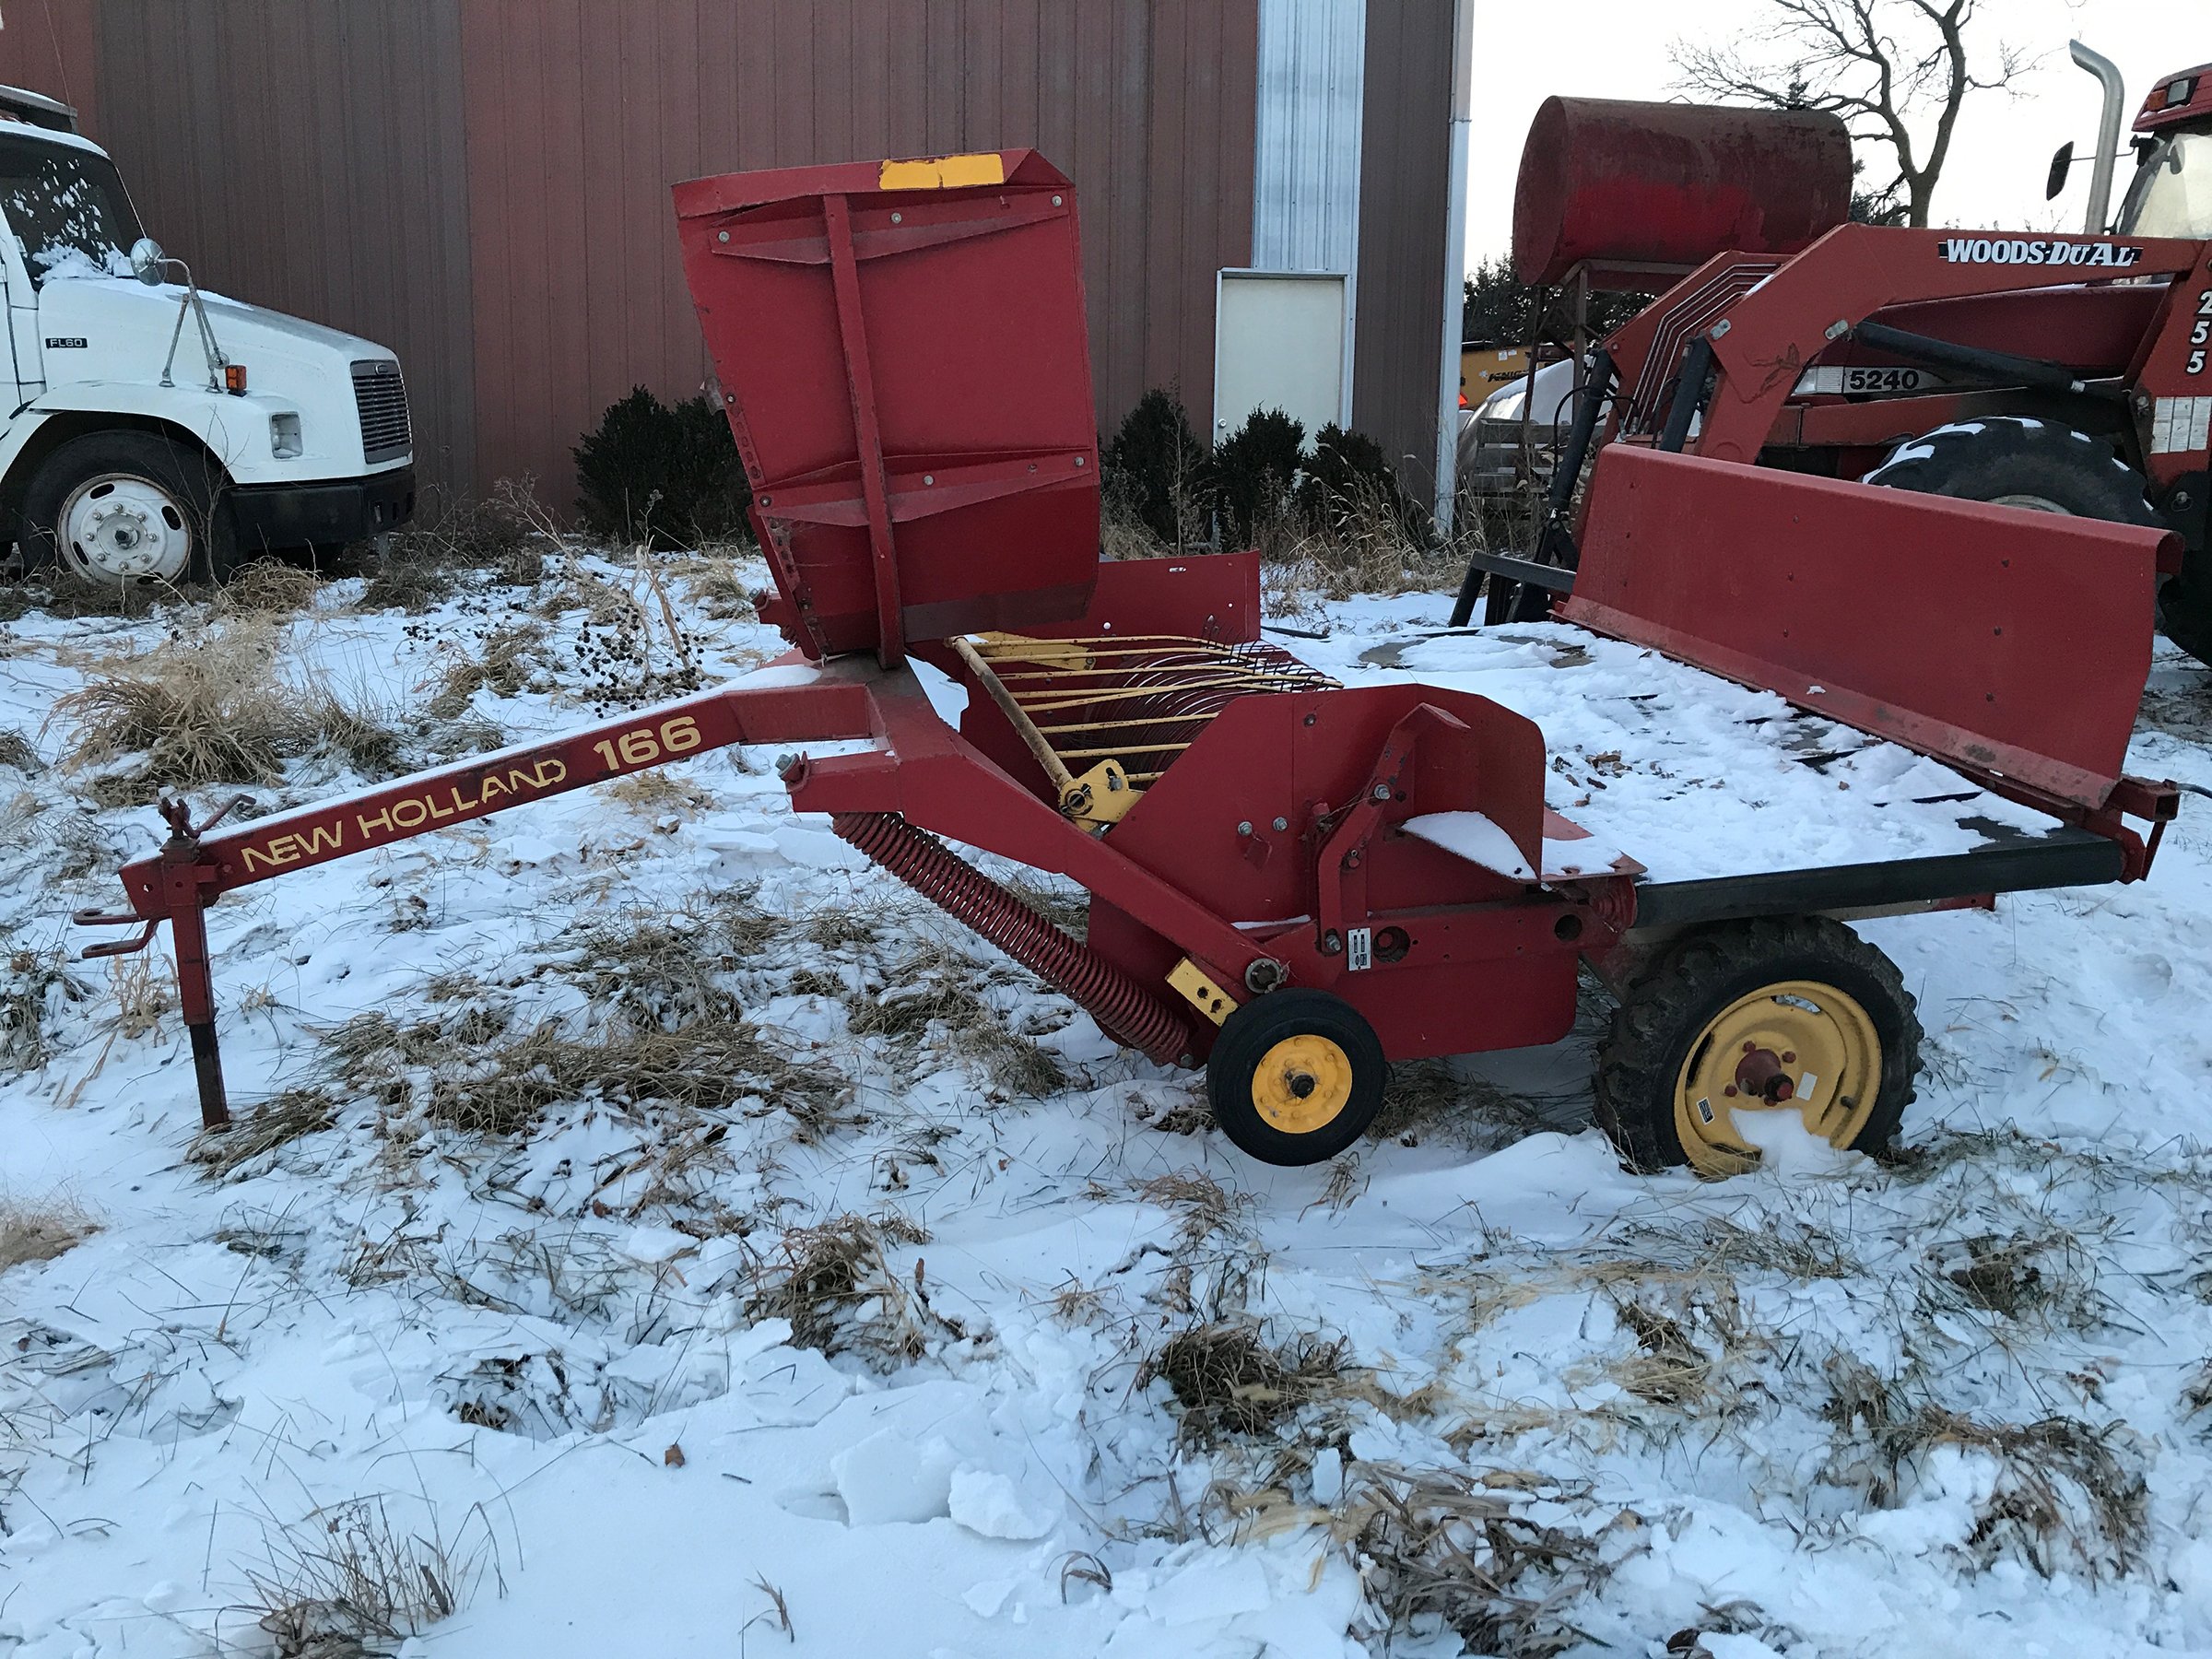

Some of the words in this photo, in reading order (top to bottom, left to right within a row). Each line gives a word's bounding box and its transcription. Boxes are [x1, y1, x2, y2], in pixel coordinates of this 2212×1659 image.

[50, 338, 83, 347] FL60
[1849, 370, 1920, 390] 5240
[241, 820, 343, 873] NEW
[359, 759, 568, 839] HOLLAND
[592, 715, 702, 771] 166
